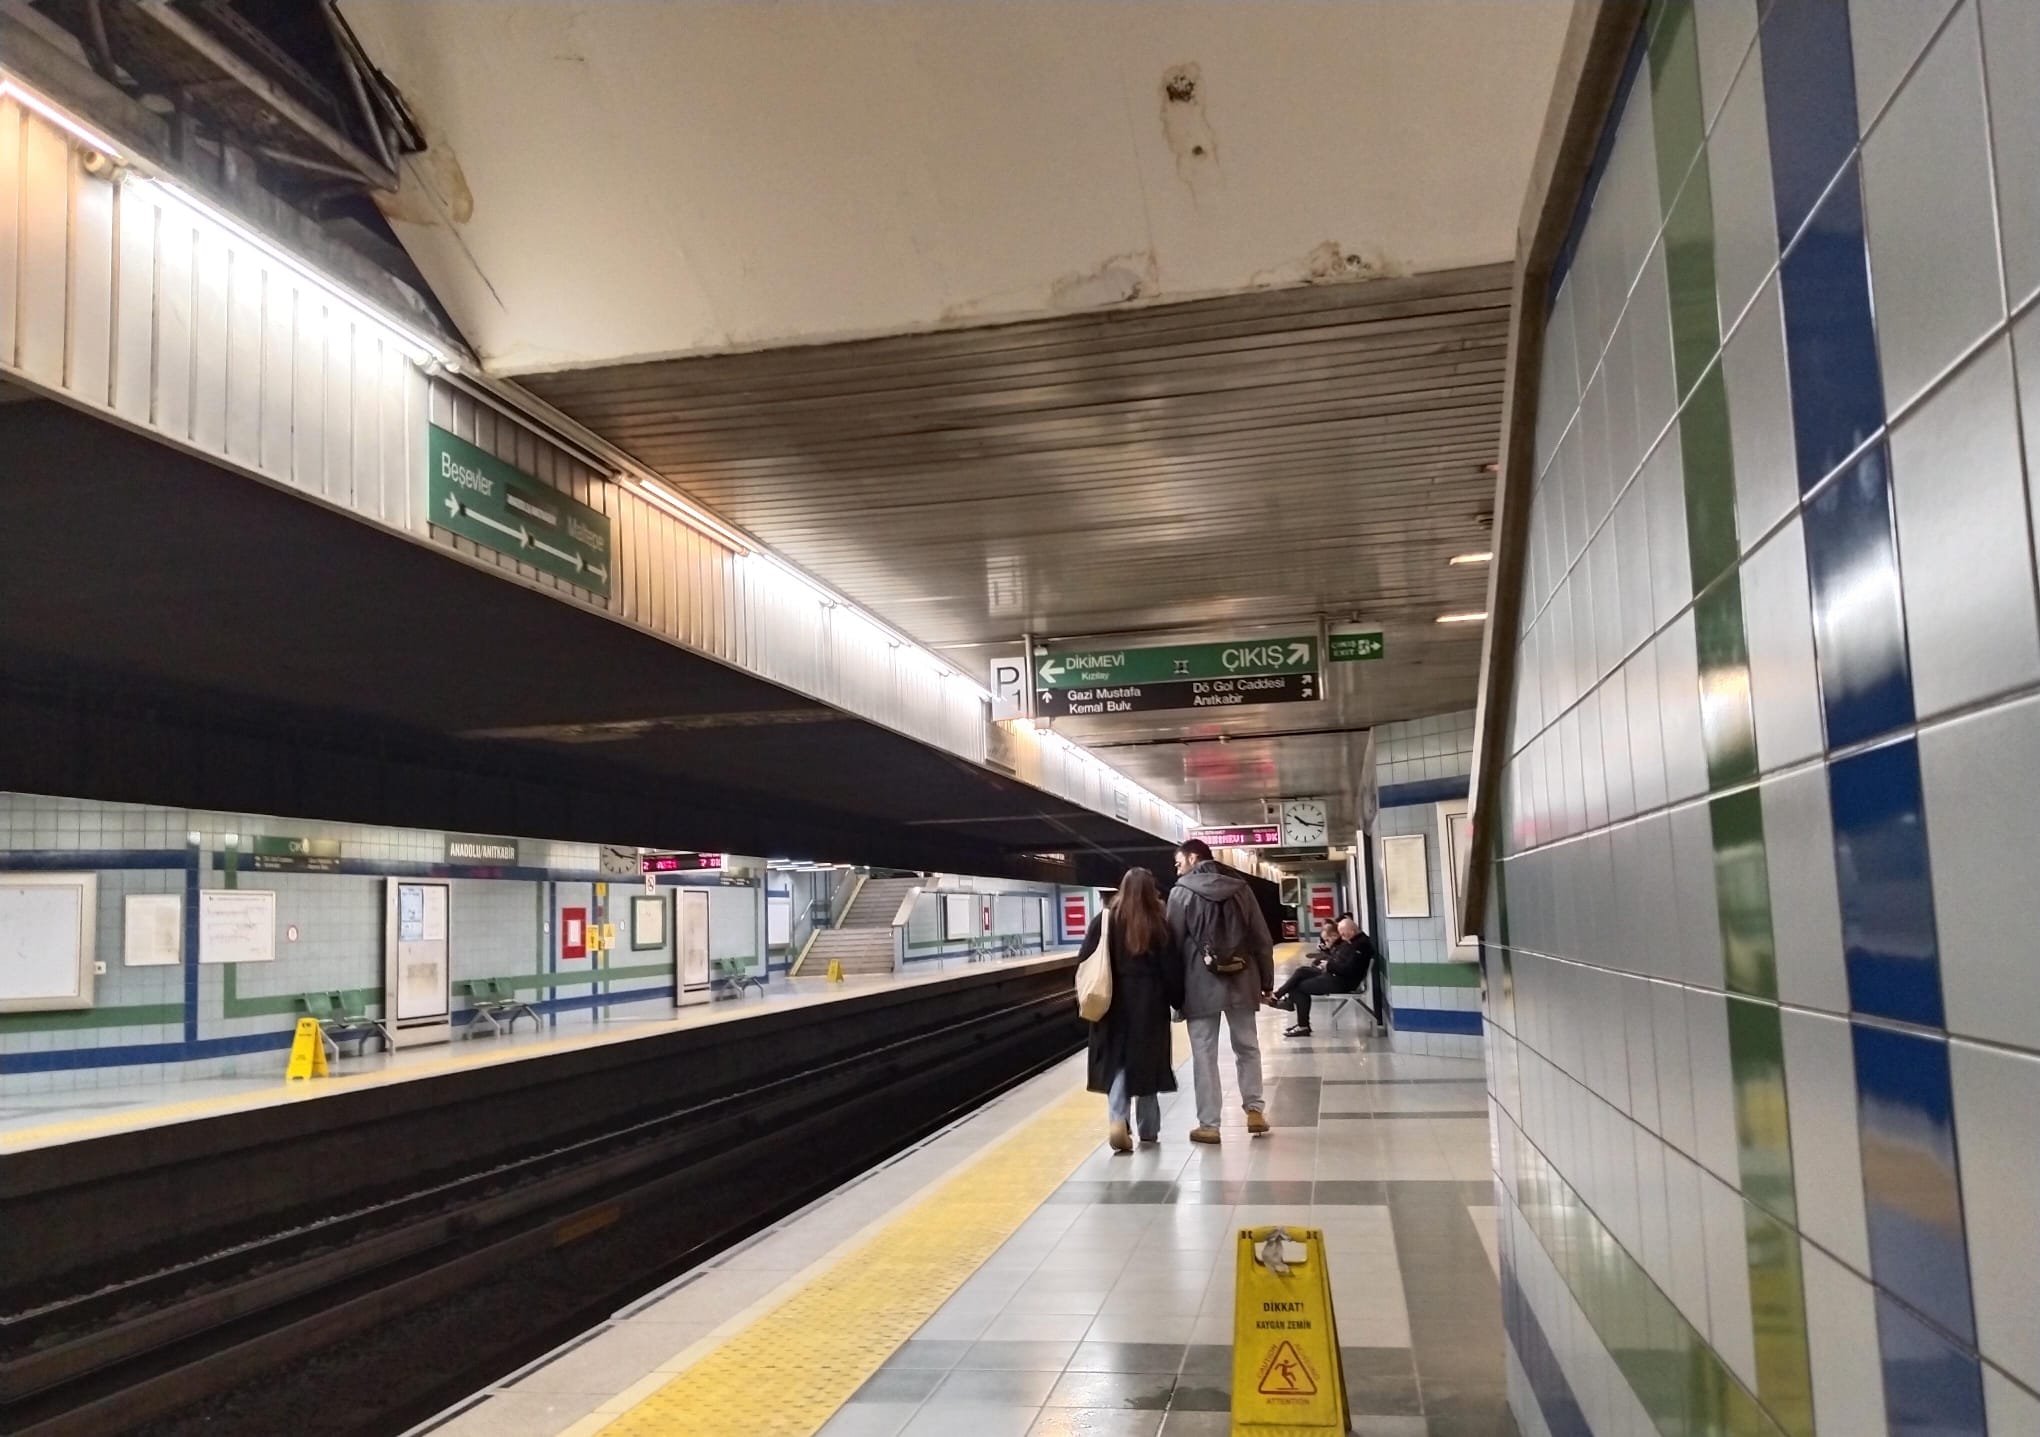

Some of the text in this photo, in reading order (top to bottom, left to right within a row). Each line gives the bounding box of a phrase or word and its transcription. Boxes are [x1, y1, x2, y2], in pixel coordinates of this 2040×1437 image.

[442, 451, 493, 496] Beşevler
[1066, 652, 1125, 670] DİKİMEVİ
[1222, 645, 1284, 672] ÇIKIŞ
[996, 667, 1020, 700] P
[1237, 677, 1286, 691] Caddesi
[1012, 688, 1022, 712] 1
[1067, 686, 1142, 701] Gazi Mustafa
[1192, 693, 1244, 706] Anıtkabir
[1069, 702, 1104, 714] Kemal
[1255, 1320, 1285, 1330] KAYGAN
